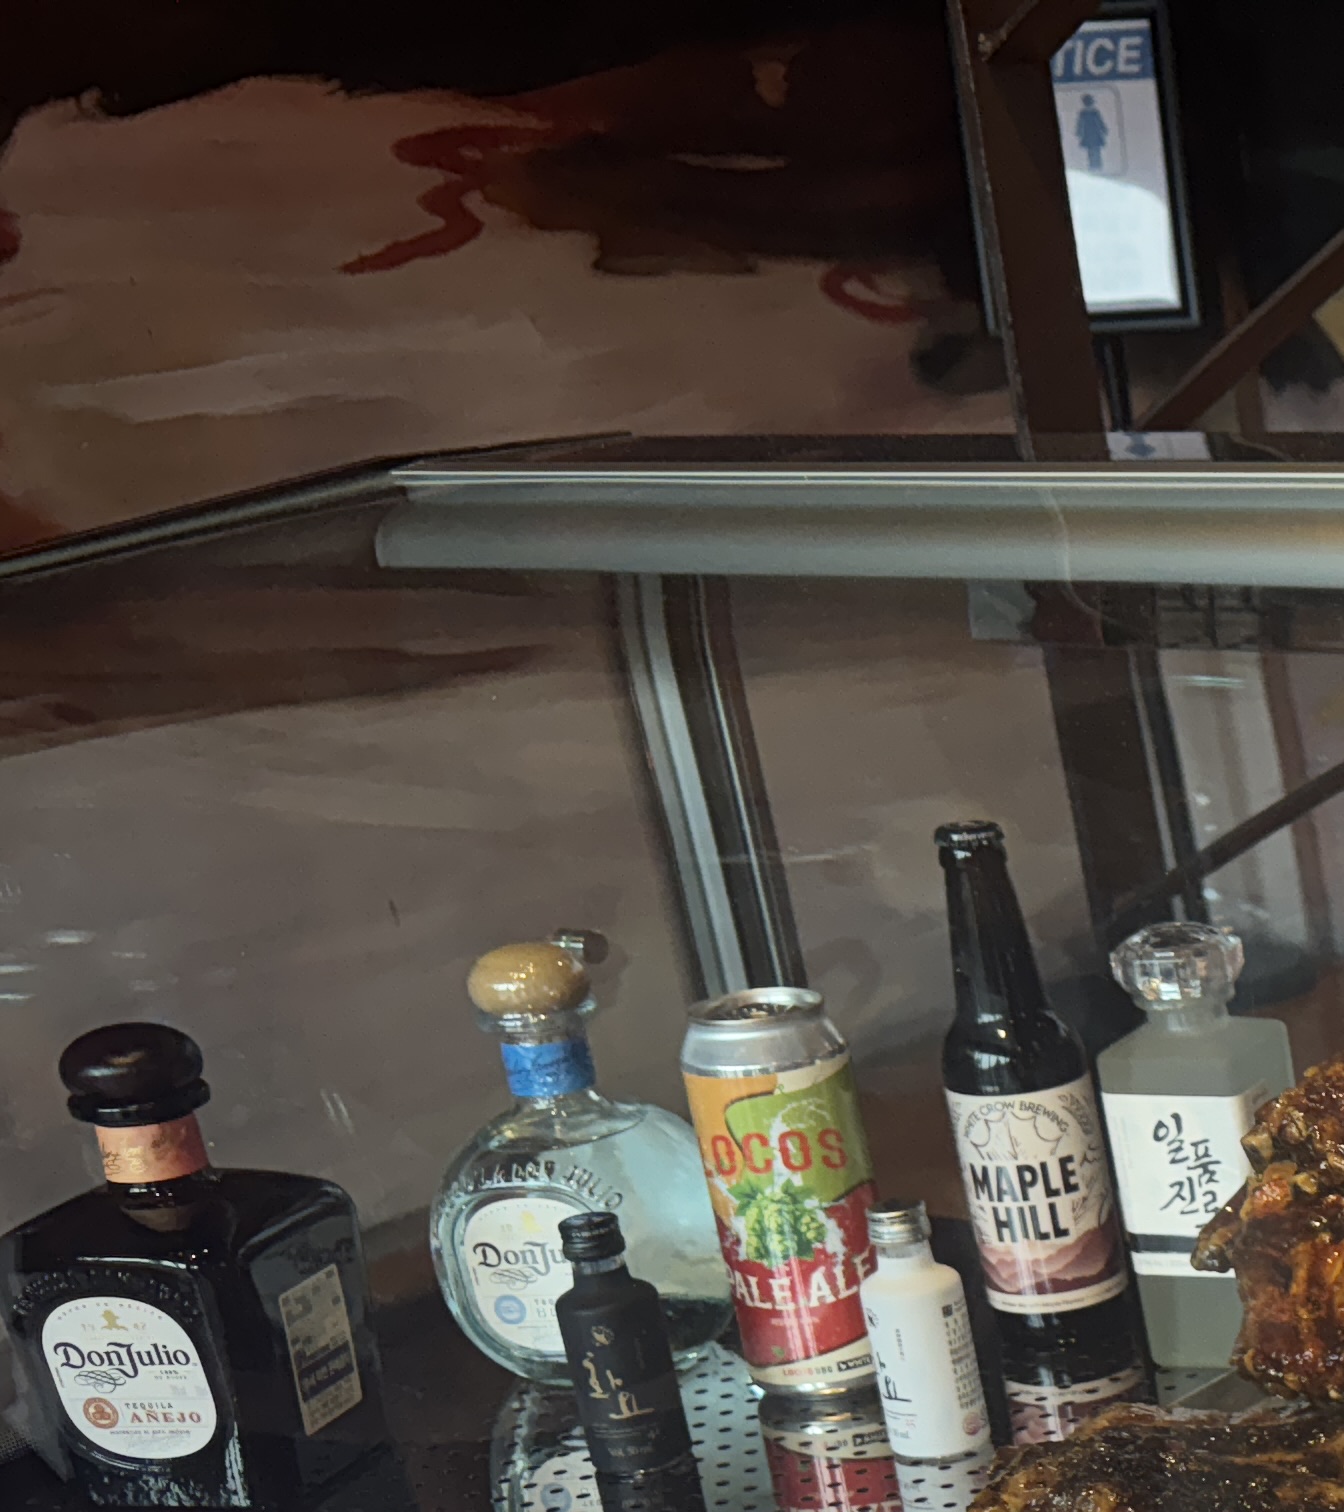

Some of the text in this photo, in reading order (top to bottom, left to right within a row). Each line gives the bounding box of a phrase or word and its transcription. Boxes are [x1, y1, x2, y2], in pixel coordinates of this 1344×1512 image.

[1053, 36, 1144, 77] TICE
[979, 1100, 1016, 1116] CROW
[1019, 1100, 1069, 1133] BREWING
[969, 1155, 1080, 1203] MAPLE
[991, 1201, 1070, 1243] HILL
[809, 1249, 875, 1309] ALE
[131, 1409, 202, 1423] AÑEJO
